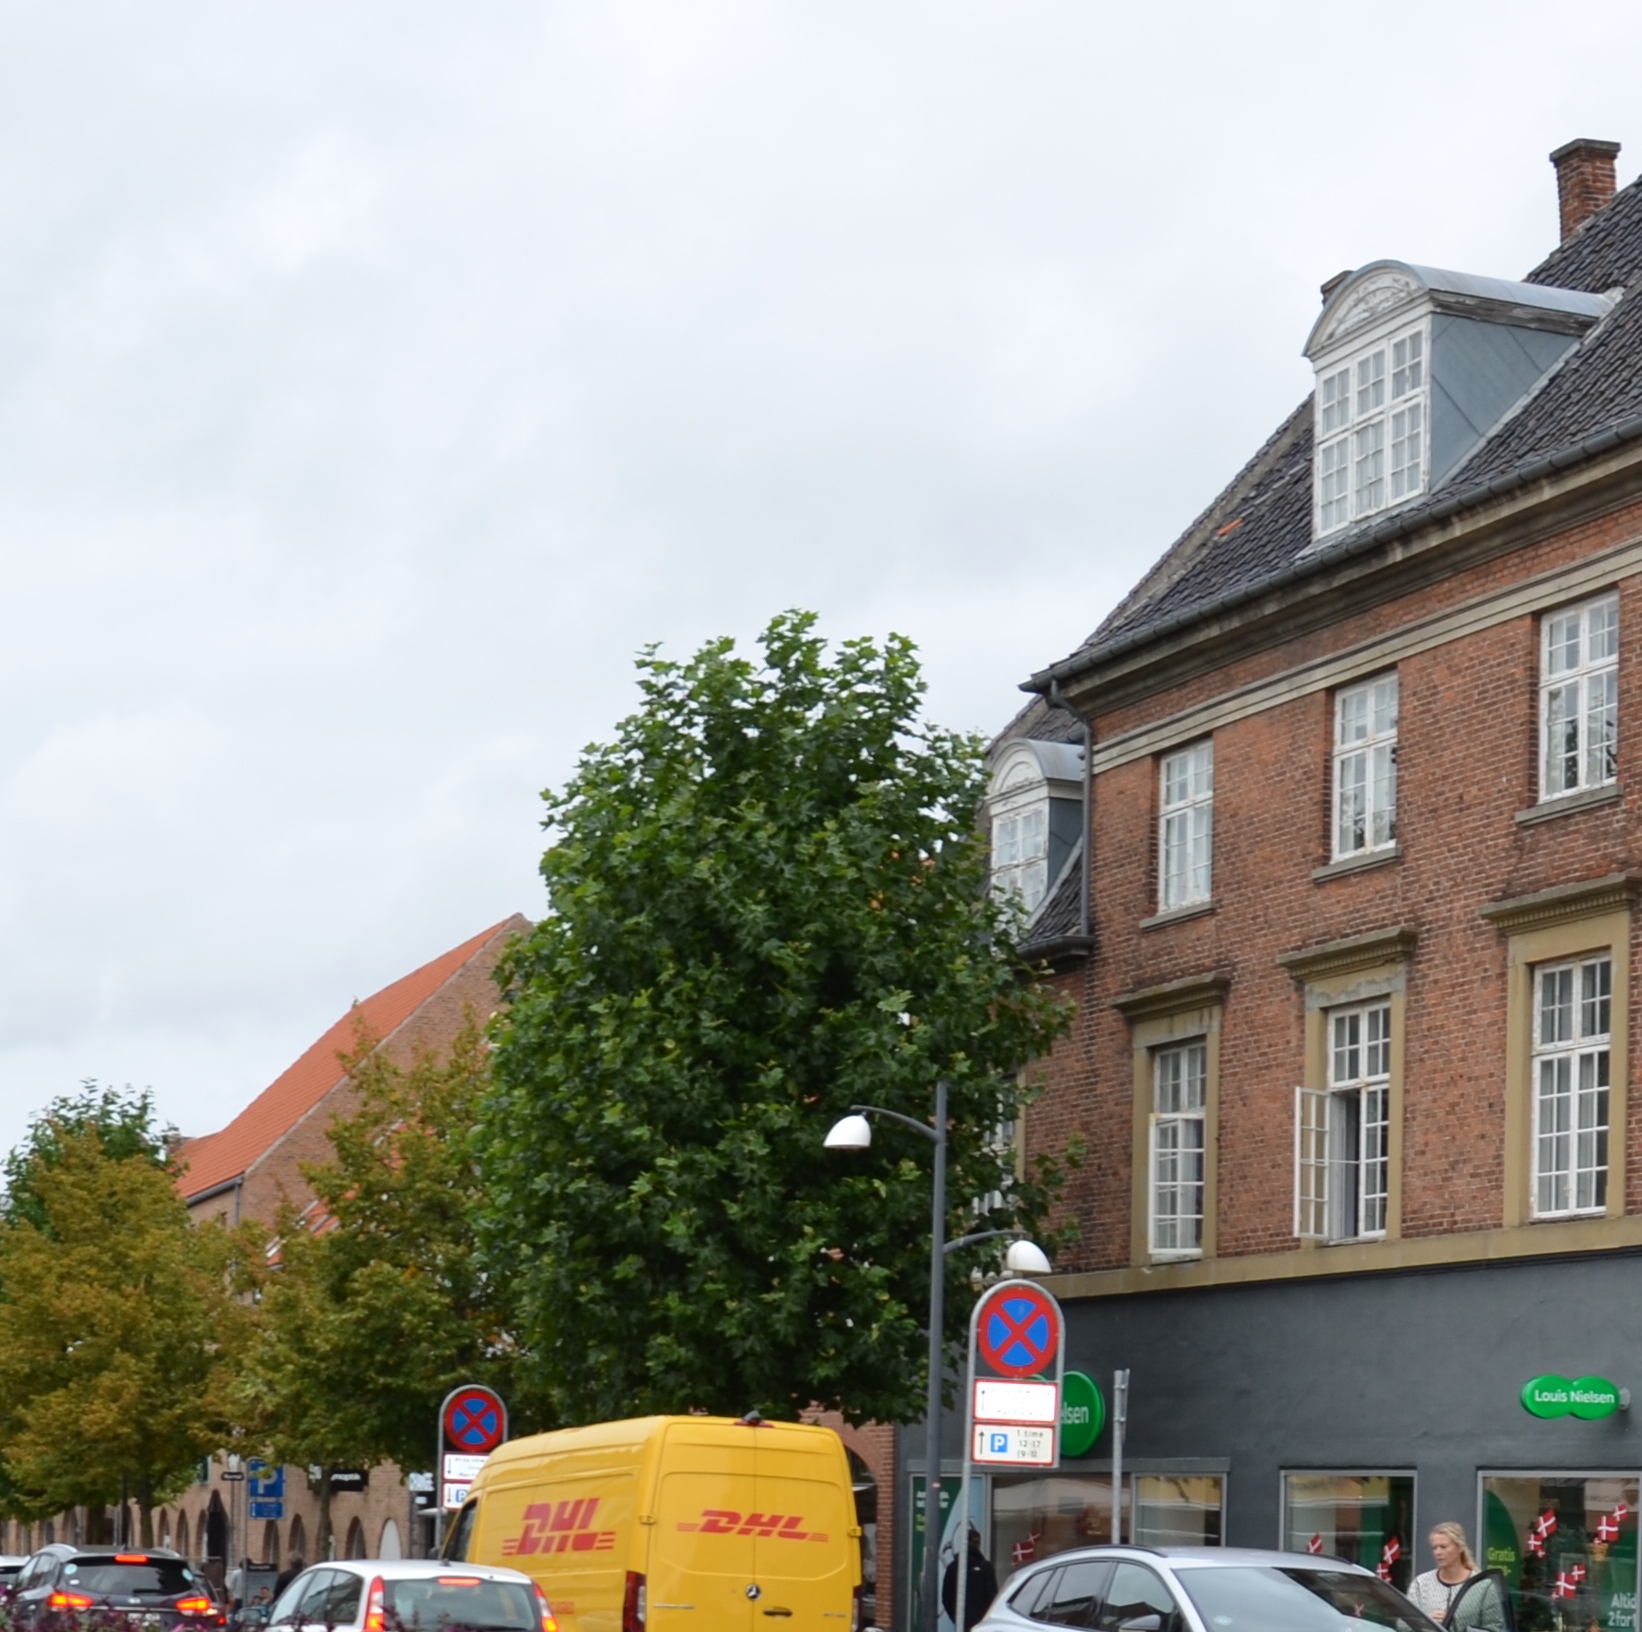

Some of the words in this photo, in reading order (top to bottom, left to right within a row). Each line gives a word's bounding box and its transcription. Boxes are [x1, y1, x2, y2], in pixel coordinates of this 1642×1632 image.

[1535, 1389, 1567, 1402] Louis
[1571, 1391, 1615, 1404] Nielsen
[257, 1465, 278, 1494] P
[515, 1498, 602, 1555] DHL
[698, 1510, 810, 1541] DHL
